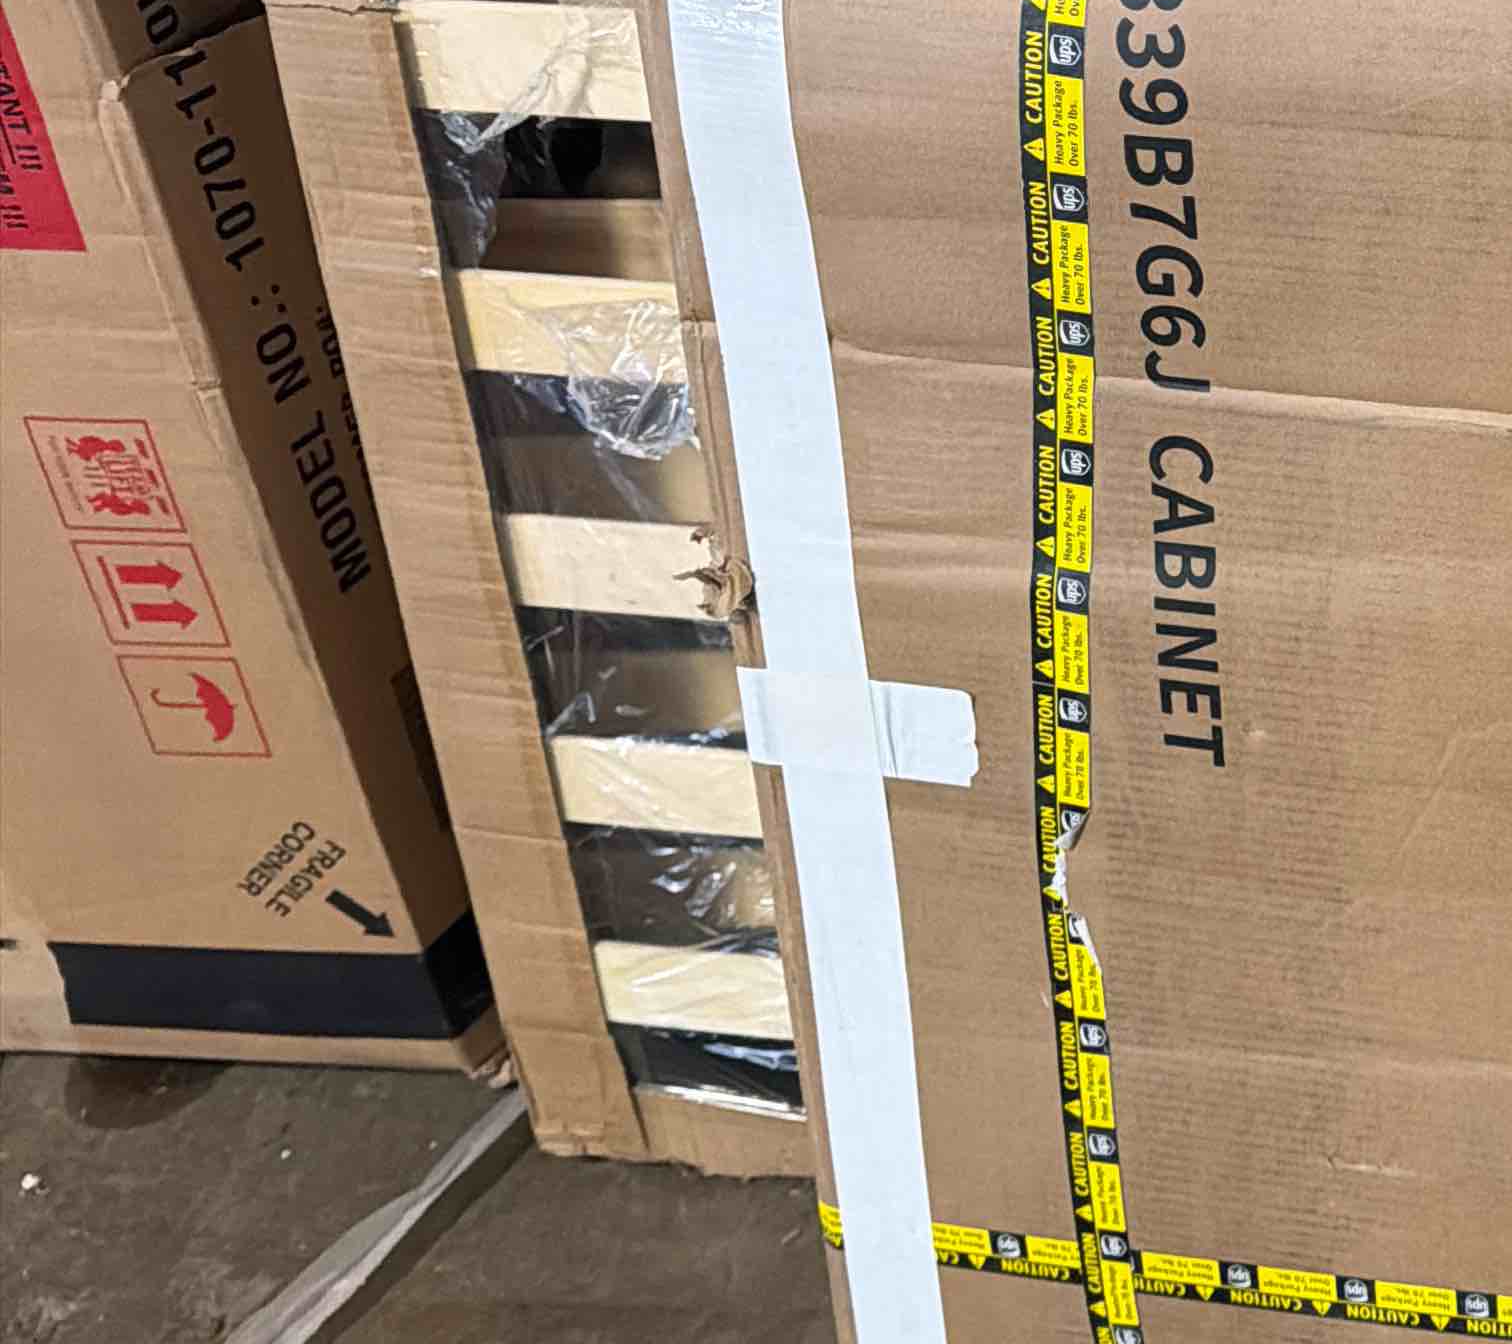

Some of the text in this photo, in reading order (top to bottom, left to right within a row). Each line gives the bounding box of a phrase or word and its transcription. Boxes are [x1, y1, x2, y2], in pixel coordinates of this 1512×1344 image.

[1023, 30, 1044, 124] CAUTION
[1054, 130, 1068, 165] Heavy
[1029, 181, 1050, 265] CAUTION
[1060, 271, 1072, 303] Heavy
[1035, 316, 1056, 396] CAUTION
[286, 409, 371, 594] MODEL
[1038, 445, 1055, 524] CAUTION
[1033, 572, 1053, 649] CAUTION
[1148, 433, 1226, 766] CABINET
[1036, 693, 1054, 766] CAUTION
[235, 822, 315, 897] CORNER
[264, 840, 346, 917] FRAGILE
[1048, 913, 1069, 982] CAUTION
[1060, 1022, 1080, 1090] CAUTION
[1069, 1132, 1089, 1196] CAUTION
[1081, 1232, 1101, 1294] CAUTION
[1135, 1278, 1186, 1296] CAUTI
[1230, 1290, 1303, 1312] CAUTION
[1346, 1303, 1420, 1326] CAUTION
